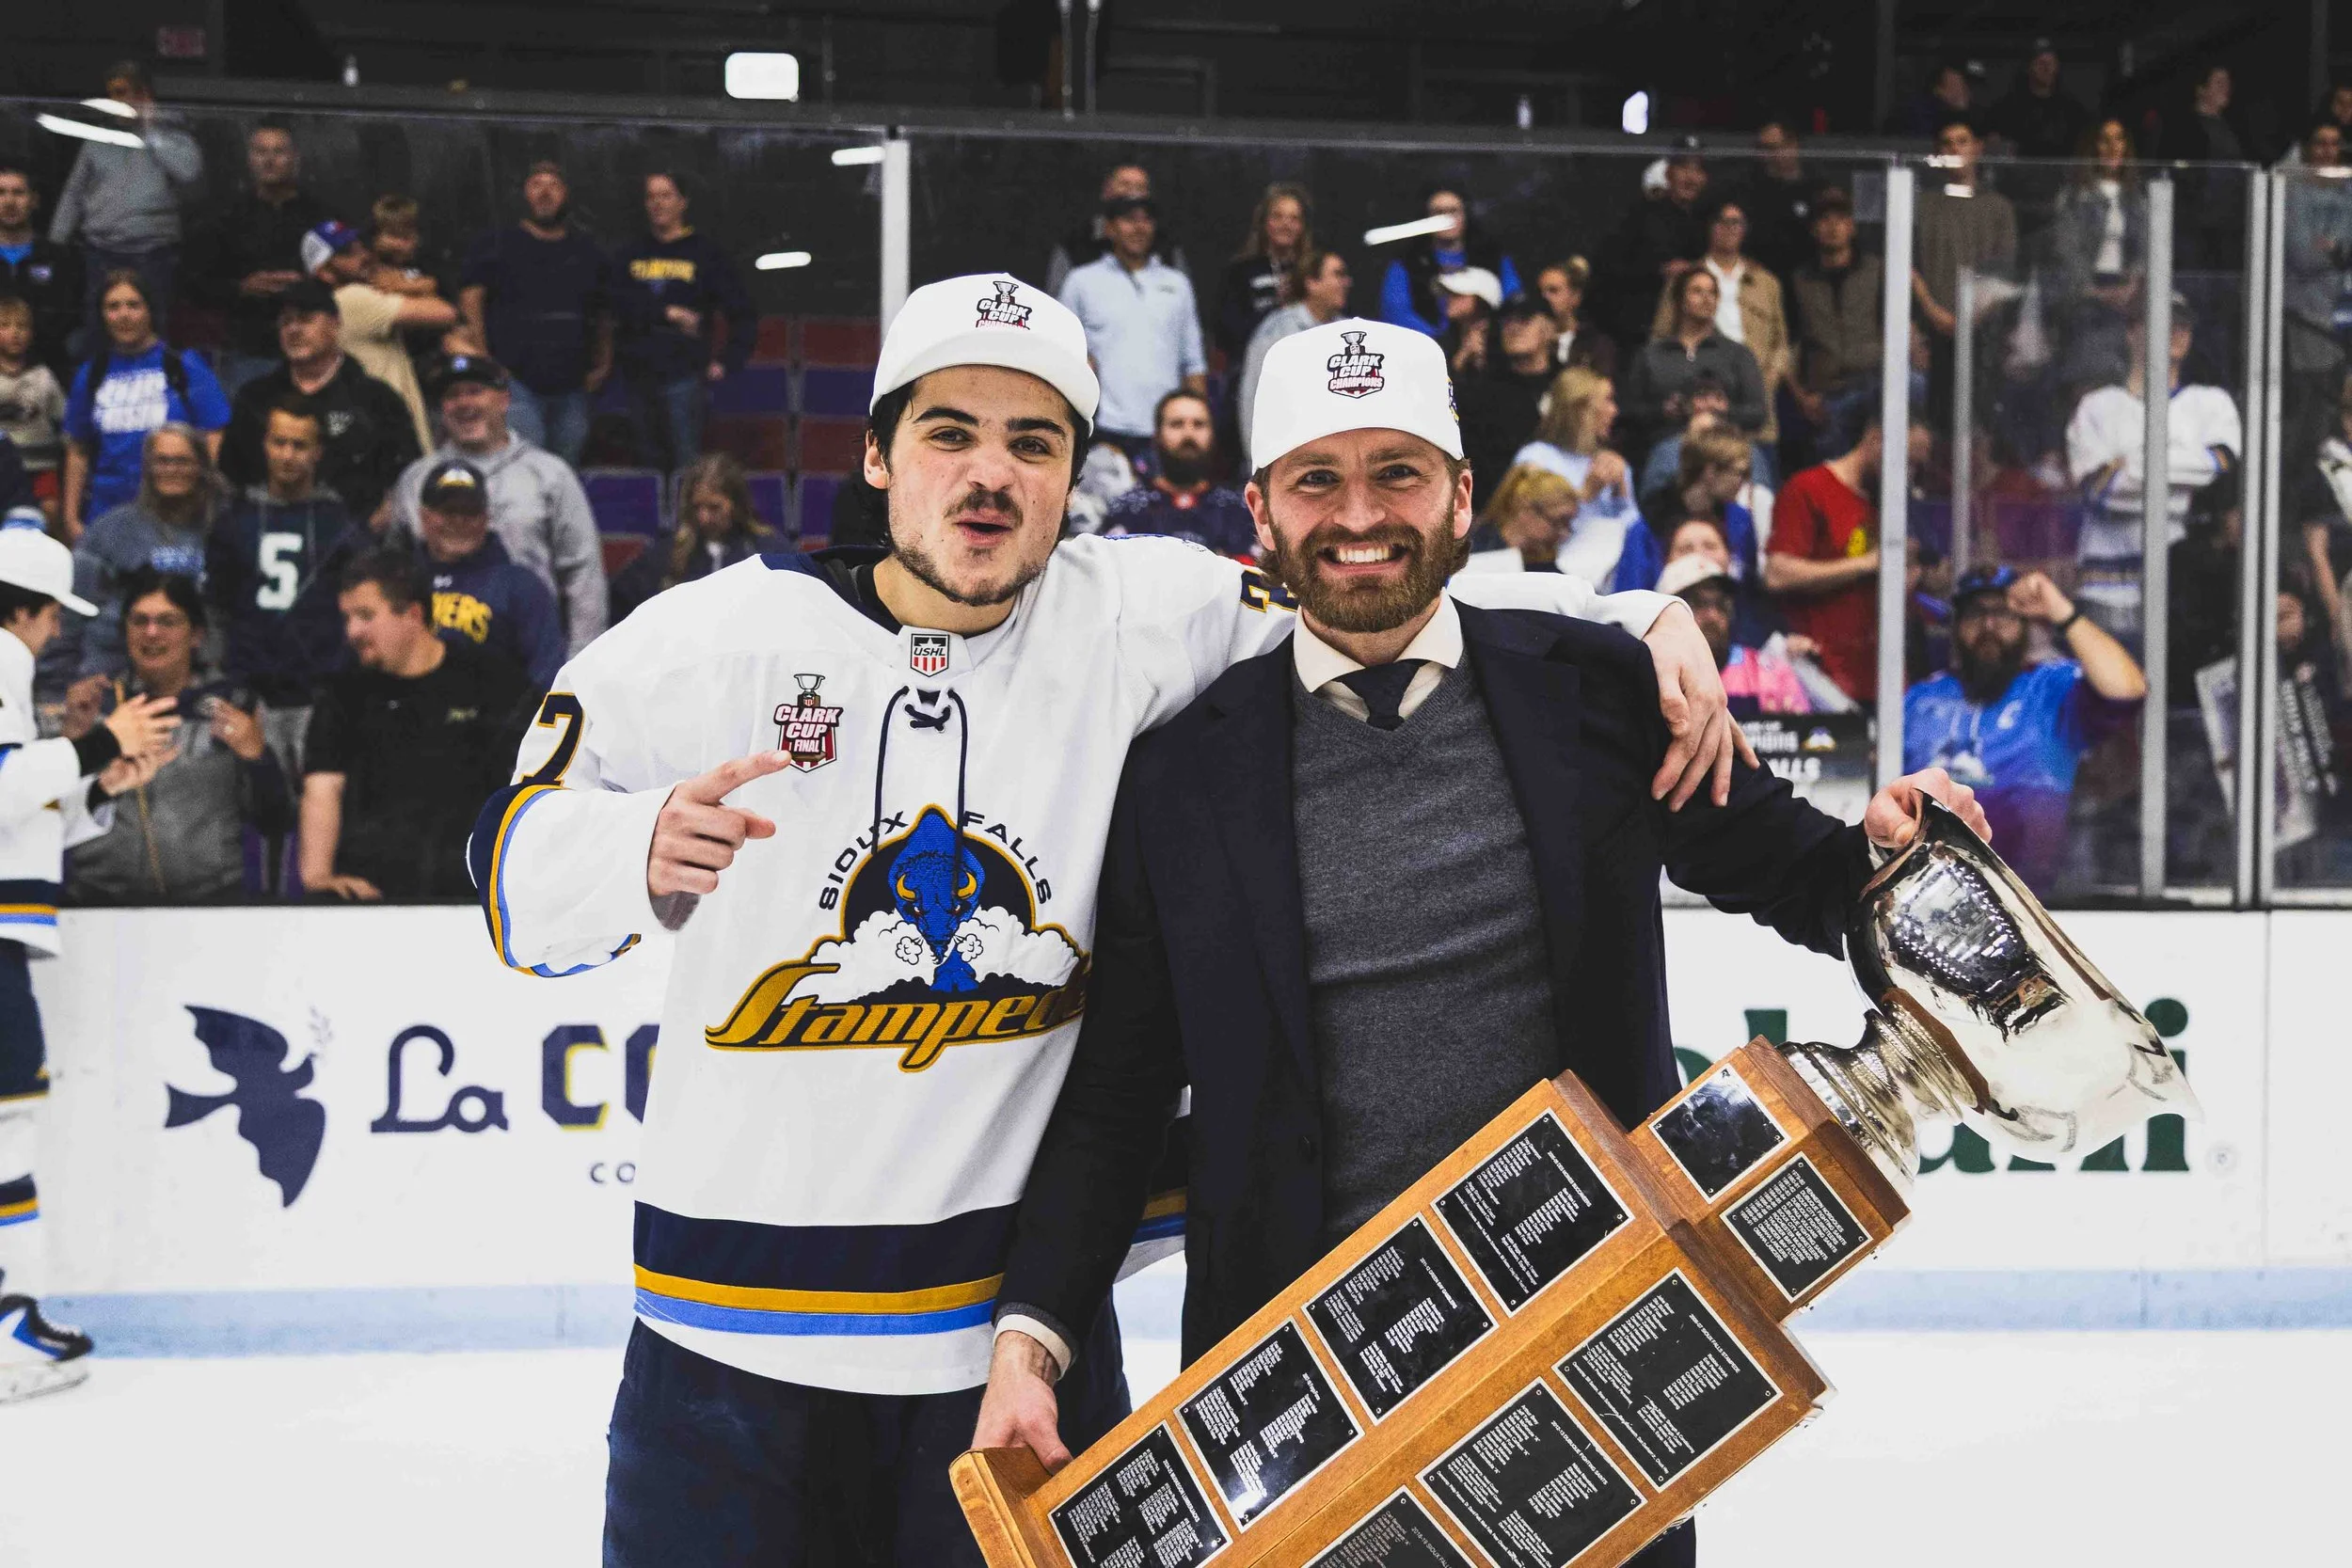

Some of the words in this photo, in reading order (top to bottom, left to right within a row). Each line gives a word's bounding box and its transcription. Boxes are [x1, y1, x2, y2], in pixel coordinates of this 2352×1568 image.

[978, 299, 1029, 319] CLARK
[988, 311, 1020, 324] CUP
[1328, 354, 1382, 368] CLARK
[1329, 377, 1383, 390] CHAMPIONS
[1339, 365, 1373, 377] CUP
[257, 532, 304, 610] 5
[913, 647, 946, 657] USHL
[774, 705, 840, 723] CLARK
[786, 722, 828, 738] CUP
[793, 739, 820, 752] FINAL
[818, 811, 910, 911] SIOUX
[963, 810, 1052, 905] FALLS
[371, 1023, 509, 1132] La
[1789, 1196, 1809, 1219] DUBUQUE
[1806, 1217, 1825, 1239] FIGHTING
[1822, 1236, 1837, 1253] SAINTS
[1790, 1207, 1802, 1219] PAUL
[1799, 1217, 1818, 1239] VULCANS
[1794, 1193, 1808, 1208] SIOUX
[1805, 1206, 1816, 1217] CITY
[1813, 1215, 1838, 1245] MUSKETEERS
[1799, 1189, 1819, 1212] DUBUQUE
[1816, 1210, 1835, 1230] FIGHTING
[1832, 1228, 1847, 1245] SAINTS
[1804, 1185, 1824, 1209] HENNEPIN
[1820, 1206, 1844, 1232] NORDIQUES
[1752, 1226, 1768, 1243] OMAHA
[1765, 1241, 1784, 1262] LANCERS
[1756, 1222, 1772, 1240] OMAHA
[1770, 1237, 1788, 1259] LANCERS
[1761, 1219, 1781, 1241] THUNDER
[1778, 1239, 1788, 1249] BAY
[1785, 1247, 1801, 1265] FLYERS
[1766, 1215, 1786, 1237] THUNDER
[1783, 1235, 1792, 1245] BAY
[1789, 1243, 1805, 1261] FLYERS
[1771, 1212, 1795, 1239] ROCHESTER
[1791, 1236, 1813, 1261] MUSTANGS
[1775, 1208, 1789, 1223] SIOUX
[1787, 1220, 1797, 1232] CITY
[1794, 1230, 1820, 1260] MUSKETEERS
[1781, 1204, 1801, 1227] DUBUQUE
[1797, 1225, 1817, 1246] FIGHTING
[1813, 1243, 1828, 1260] SAINTS
[1700, 1326, 1713, 1341] SIOUX
[1710, 1338, 1724, 1353] FALLS
[1720, 1351, 1740, 1373] STAMPEDE
[1562, 1433, 1581, 1454] DUBUQUE
[1578, 1451, 1597, 1472] FIGHTING
[1593, 1469, 1608, 1485] SAINTS
[1424, 1542, 1440, 1559] SIOUX
